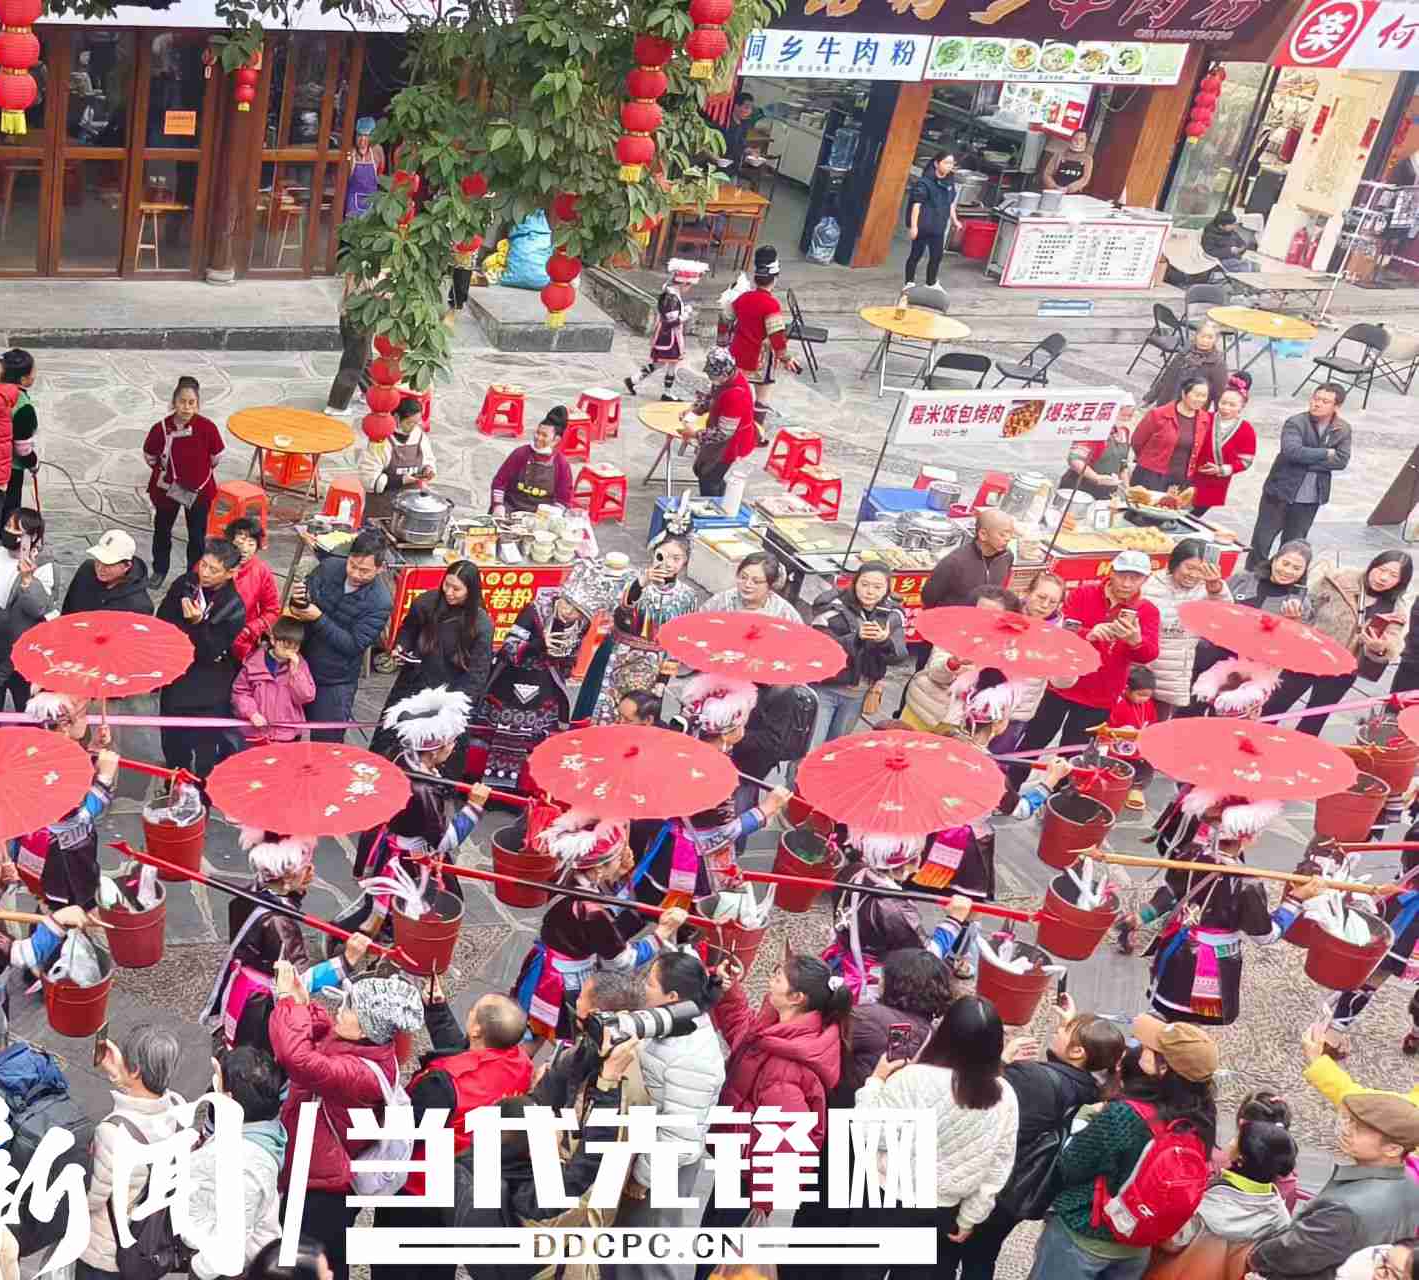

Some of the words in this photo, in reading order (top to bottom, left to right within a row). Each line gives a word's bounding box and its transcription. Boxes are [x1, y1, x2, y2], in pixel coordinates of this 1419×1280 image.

[908, 404, 1006, 425] 糯米饭包烤肉
[1044, 402, 1117, 423] 爆浆豆腐
